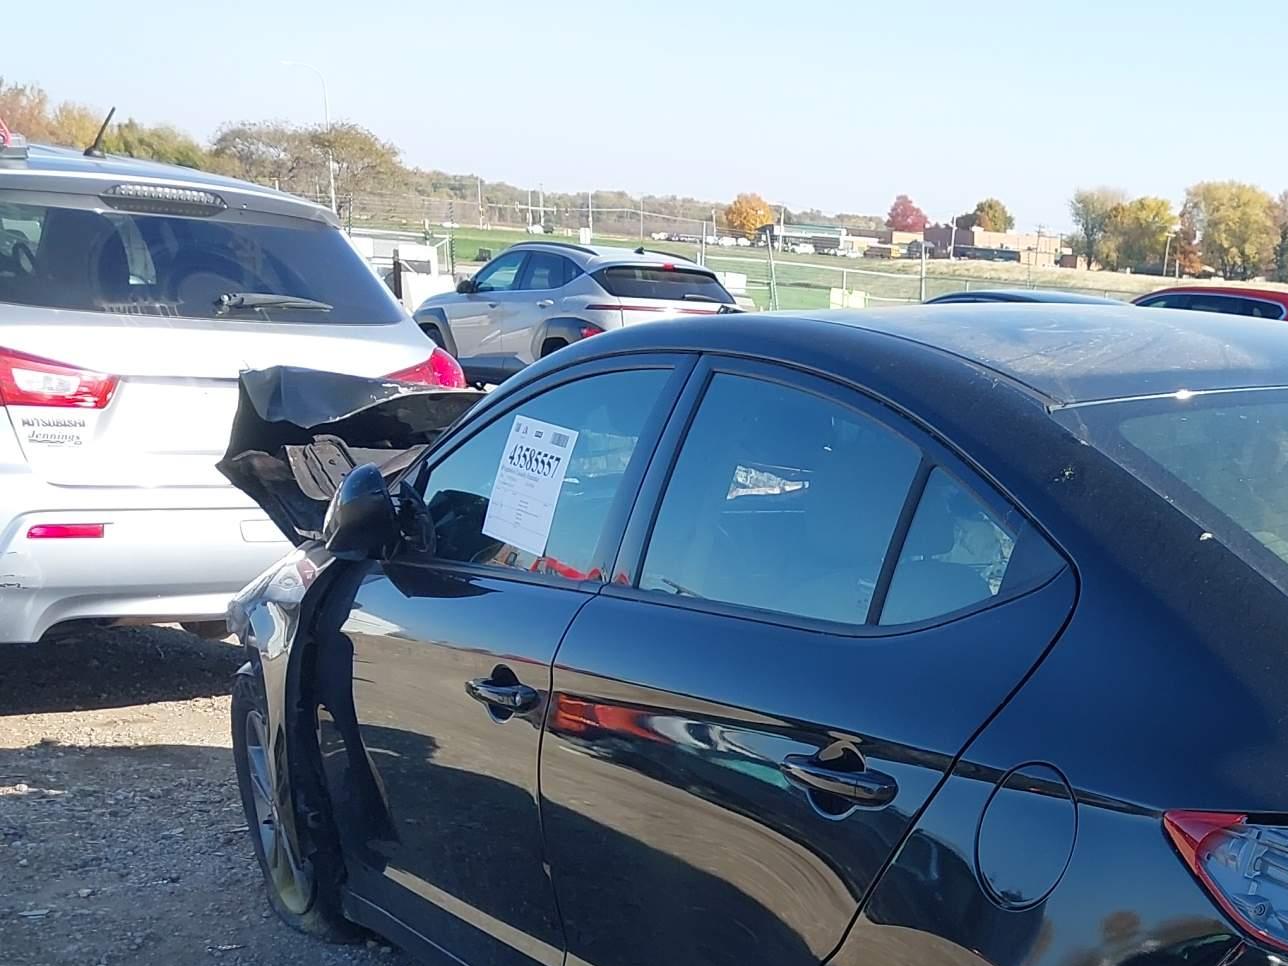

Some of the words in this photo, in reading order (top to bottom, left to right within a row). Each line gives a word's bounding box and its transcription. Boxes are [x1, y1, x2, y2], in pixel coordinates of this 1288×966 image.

[21, 417, 86, 428] MITSUBISHI
[28, 430, 81, 442] Jennings
[509, 443, 561, 478] 43585557
